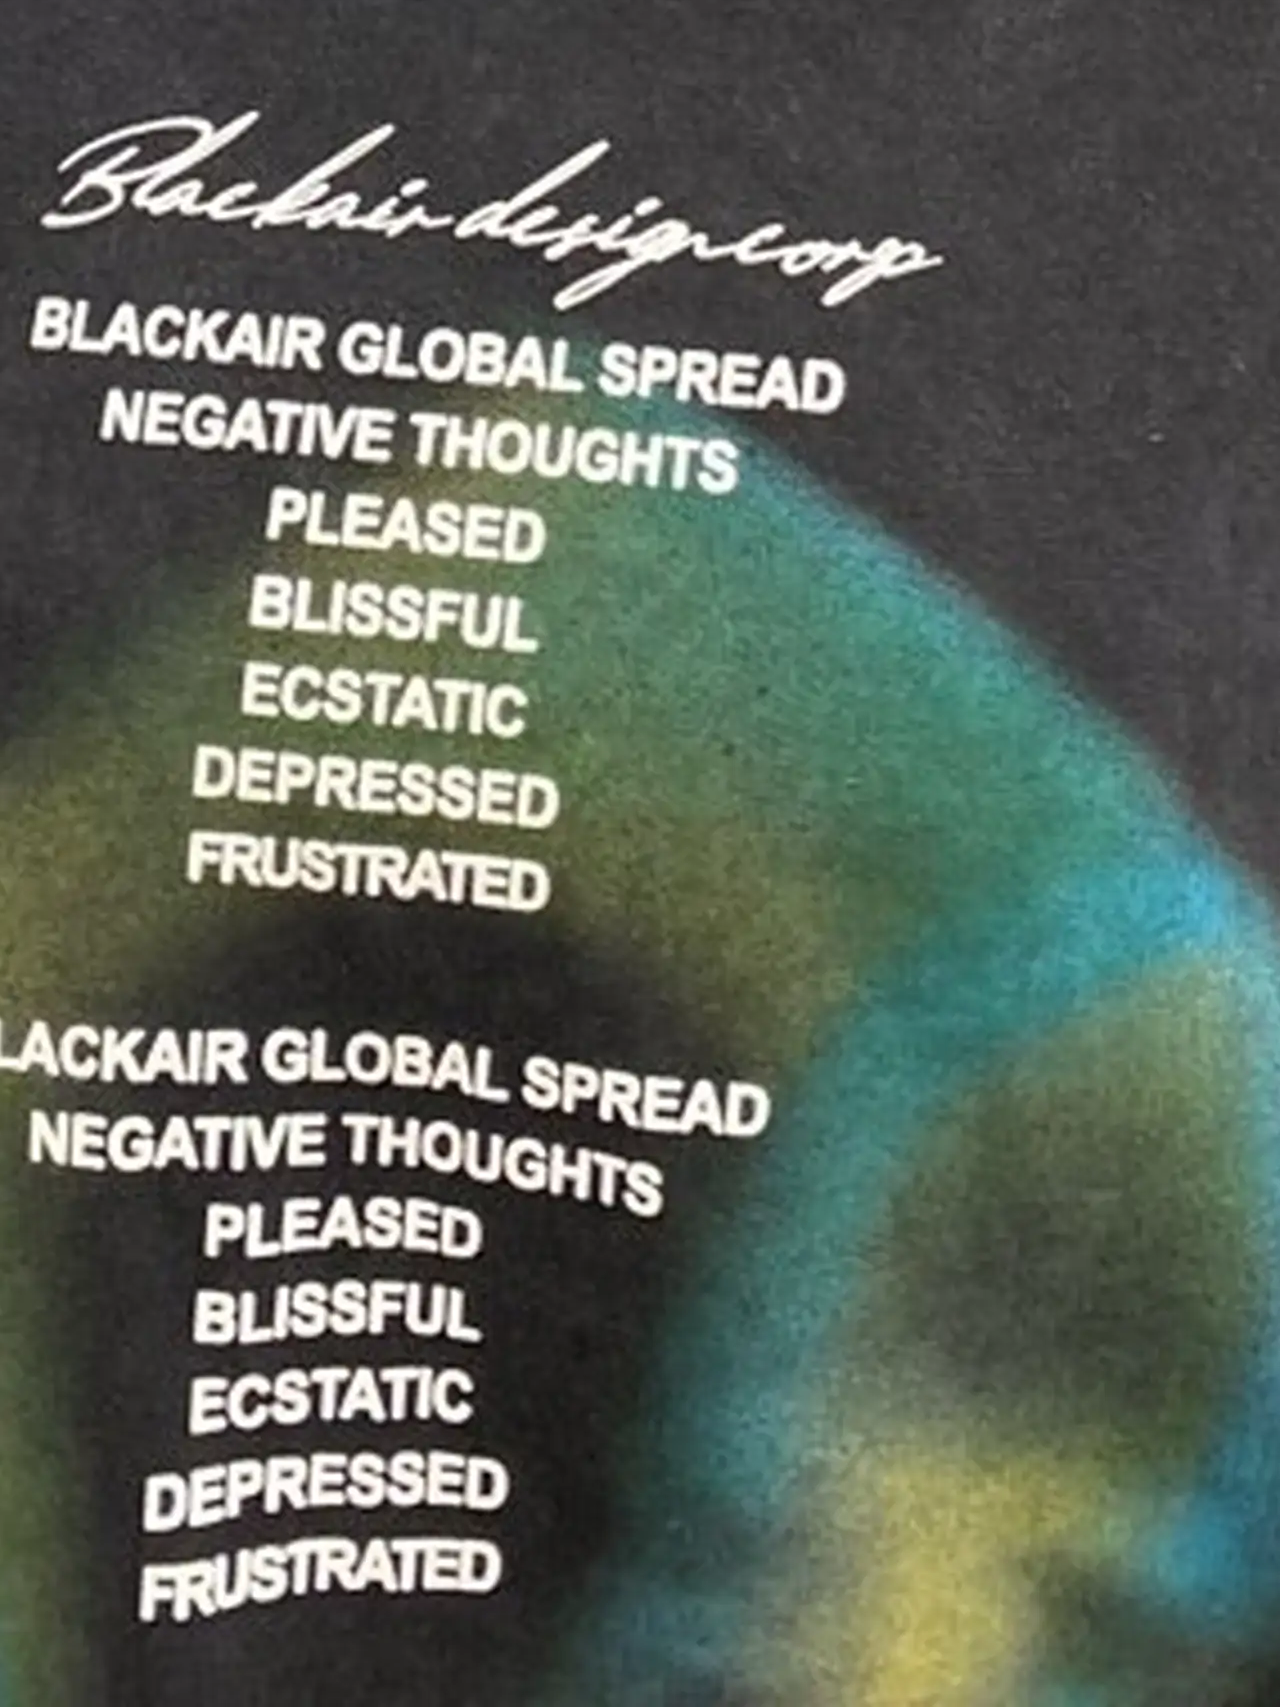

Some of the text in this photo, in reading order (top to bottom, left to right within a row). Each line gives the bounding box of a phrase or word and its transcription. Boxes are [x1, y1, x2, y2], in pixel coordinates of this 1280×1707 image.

[41, 110, 454, 239] Blackair
[29, 295, 847, 415] BLACKAIR GLOBAL SPREAD
[99, 387, 741, 496] NEGATIVE THOUGHTS
[265, 486, 548, 565] PLEASED
[248, 572, 540, 654] BLISSFUL
[240, 660, 530, 739] ECSTATIC
[191, 743, 561, 829] DEPRESSED
[186, 829, 551, 912] FRUSTRATED
[261, 1027, 511, 1103] GLOBAL
[520, 1055, 772, 1138] SPREAD
[28, 1109, 664, 1217] NEGATIVE THOUGHTS
[204, 1195, 483, 1259] PLEASED
[192, 1279, 482, 1345] BLISSFUL
[188, 1365, 475, 1436] ECSTATIC
[142, 1450, 510, 1533] DEPRESSED
[138, 1536, 503, 1623] FRUSTRATED
